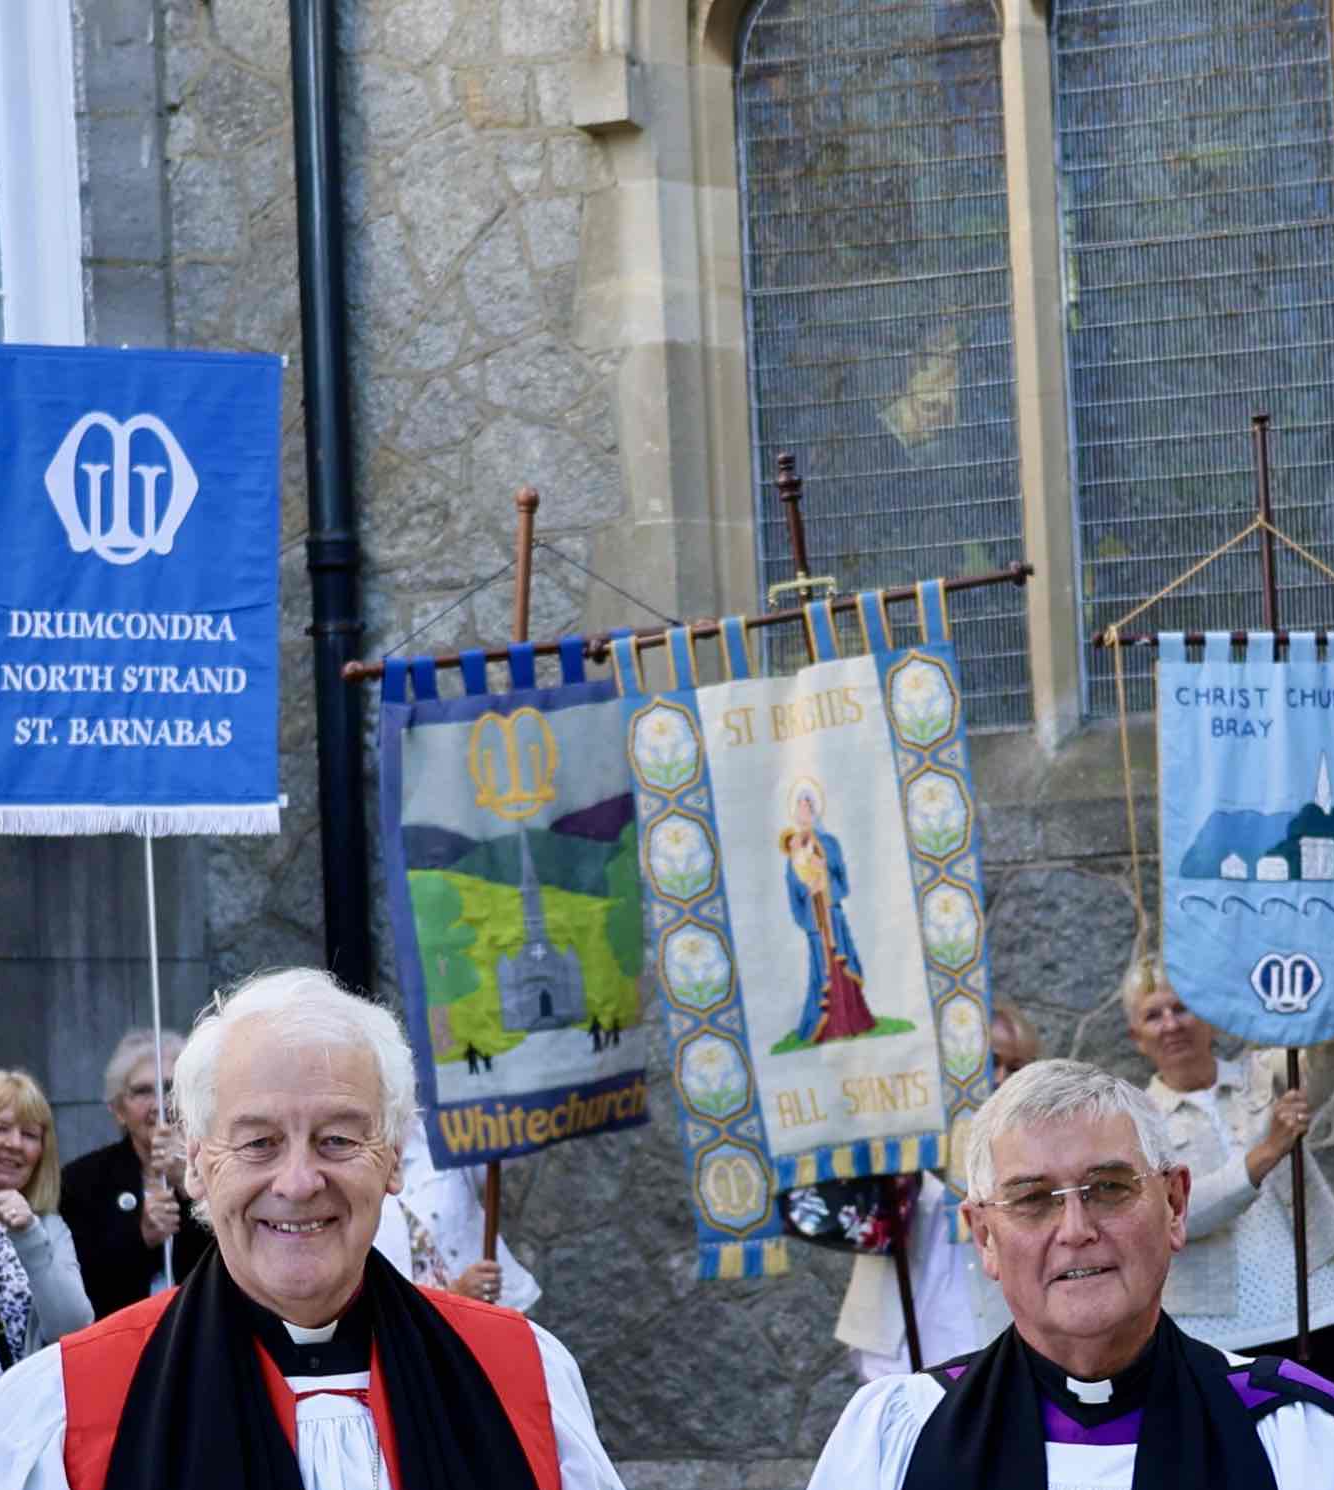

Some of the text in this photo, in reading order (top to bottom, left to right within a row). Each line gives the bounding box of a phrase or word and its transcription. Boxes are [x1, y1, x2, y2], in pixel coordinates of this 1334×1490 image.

[7, 610, 236, 642] DRUMCONDRA
[1, 664, 247, 696] NORTH STRAND
[1175, 686, 1269, 709] CHRIST
[14, 719, 232, 748] ST. BARNABAS
[1211, 719, 1274, 738] BRAY
[439, 1077, 648, 1154] Whitechurch
[778, 1088, 827, 1128] ALL
